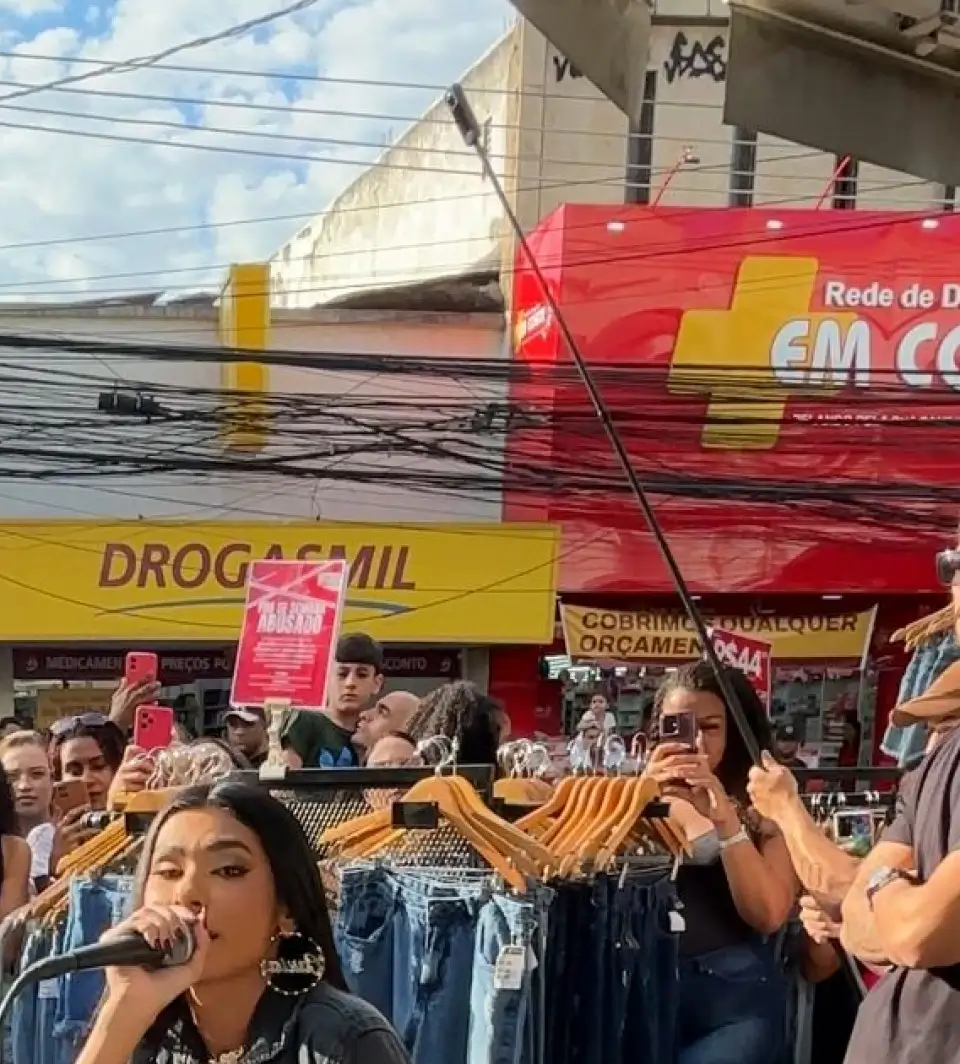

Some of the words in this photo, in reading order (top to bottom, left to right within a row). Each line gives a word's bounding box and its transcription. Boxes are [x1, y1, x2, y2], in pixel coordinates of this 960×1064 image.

[824, 281, 893, 308] Rede
[900, 283, 934, 308] de
[771, 319, 870, 387] EM
[580, 634, 702, 657] ORÇAMEN
[45, 656, 123, 670] MEDICAMEN
